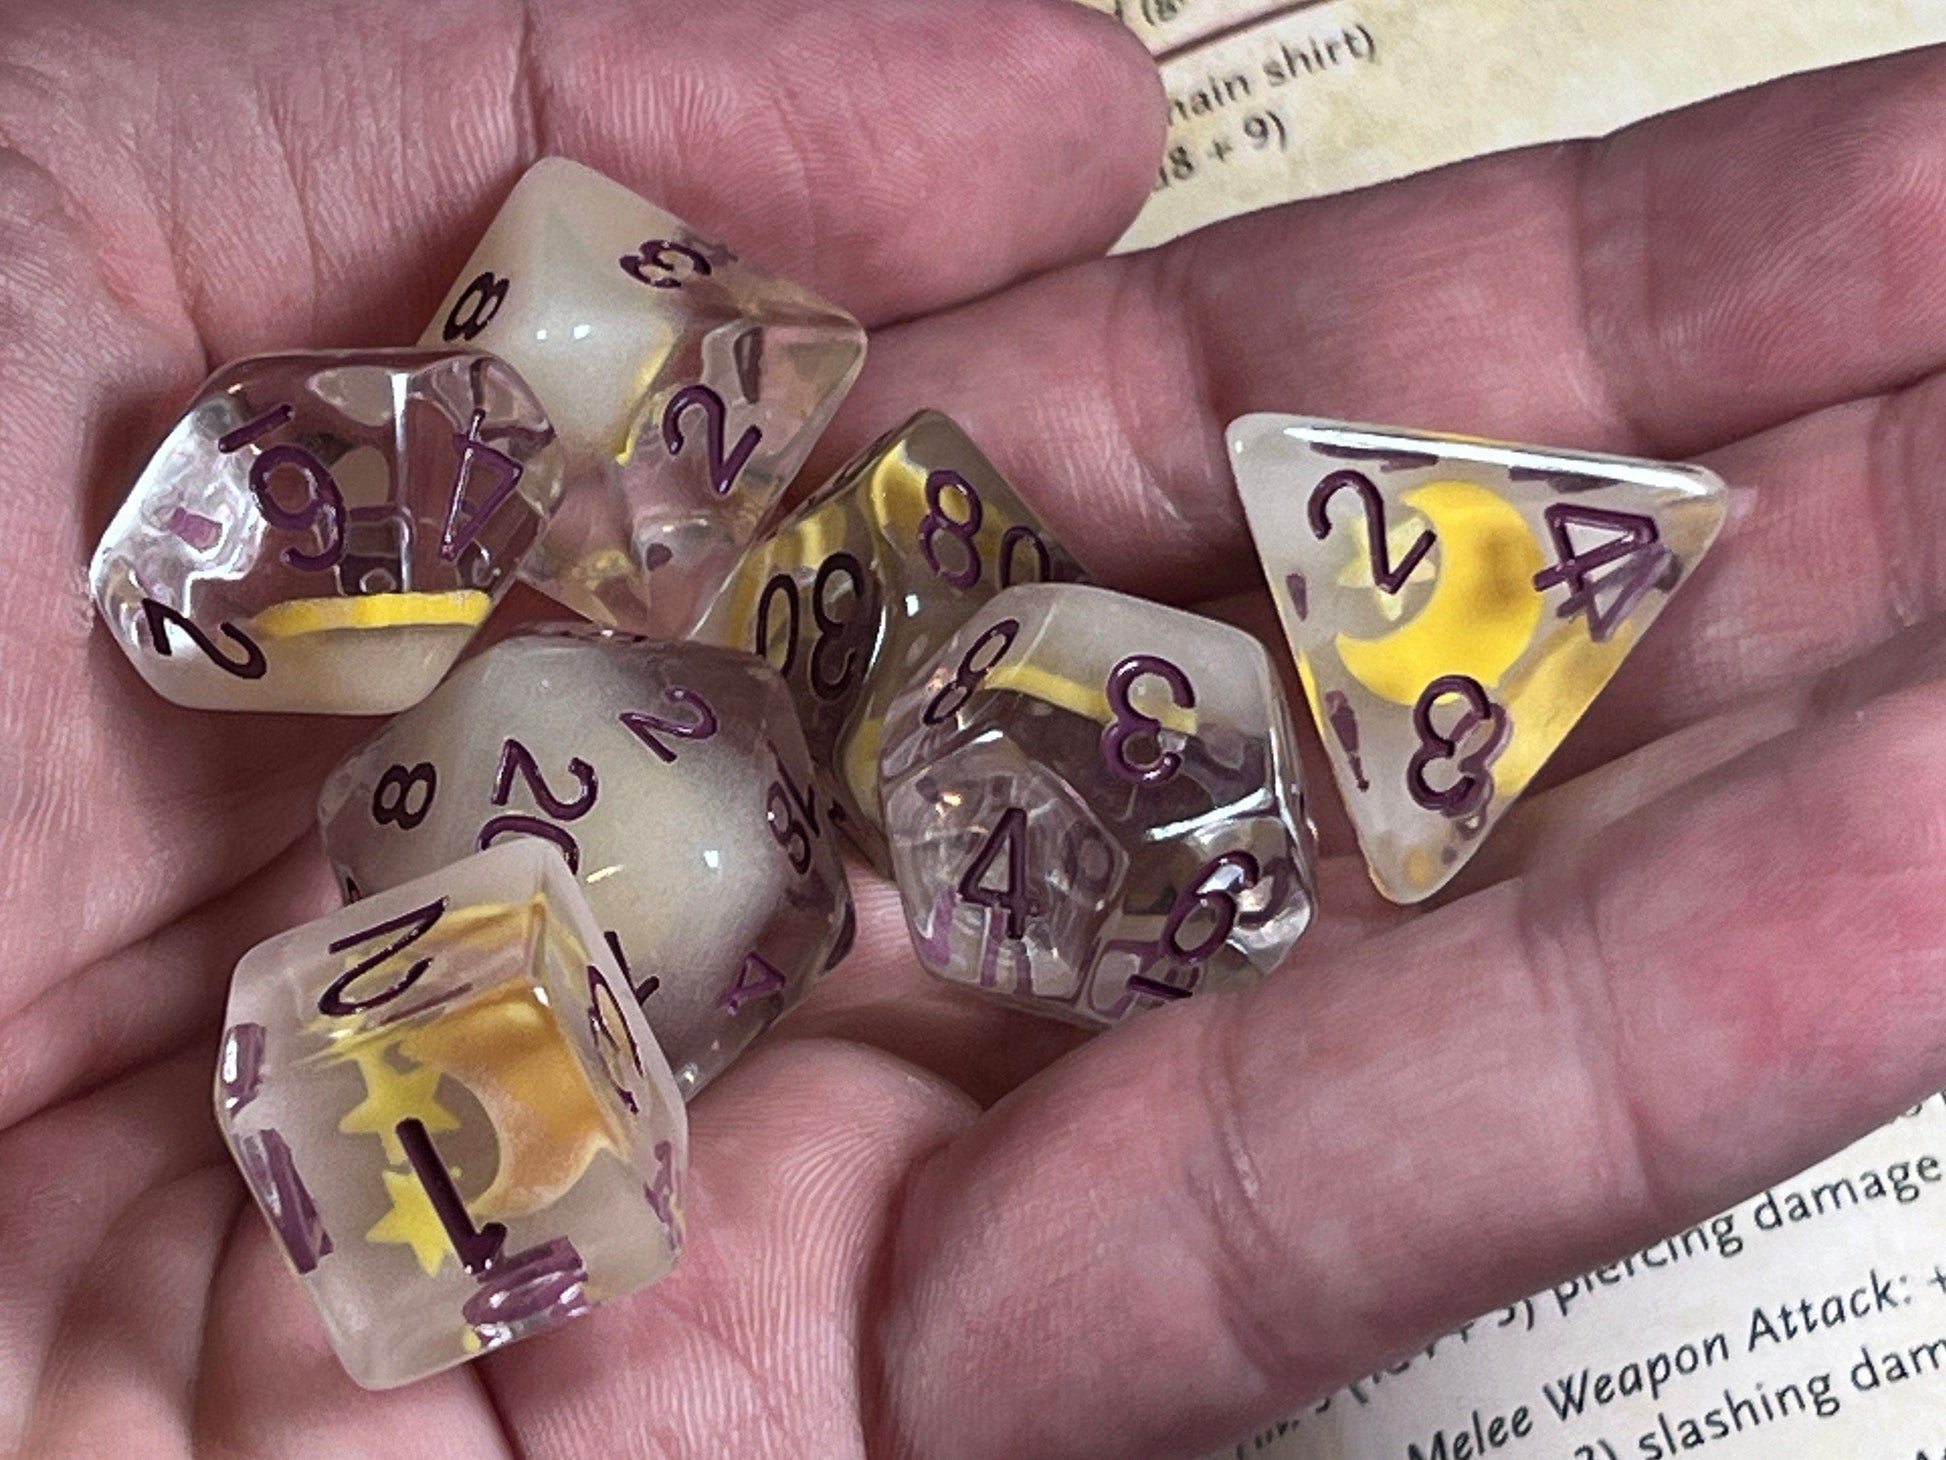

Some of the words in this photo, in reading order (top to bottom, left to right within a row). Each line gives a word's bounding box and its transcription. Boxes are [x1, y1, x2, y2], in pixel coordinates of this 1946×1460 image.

[1263, 24, 1377, 87] shirt)
[1209, 138, 1232, 162] +
[1243, 109, 1286, 150] 9)
[442, 272, 510, 342] 8
[619, 239, 712, 289] 3
[438, 408, 525, 563] 4
[662, 384, 762, 495] 2
[1308, 470, 1437, 595] 2
[1533, 502, 1659, 606] 4
[141, 597, 268, 680] 2
[921, 618, 1020, 726] 8
[619, 686, 717, 763] 2
[1103, 654, 1196, 788] 3
[1406, 674, 1492, 803] 3
[372, 761, 437, 831] 8
[958, 807, 1044, 940] 4
[318, 896, 450, 1016] 2
[395, 1117, 508, 1277] 1
[1753, 1155, 1942, 1231] damage
[1407, 1405, 1533, 1460] Melee
[1543, 1333, 1729, 1423] Weapon
[1748, 1268, 1912, 1353] Attack:
[1638, 1373, 1841, 1460] slashing
